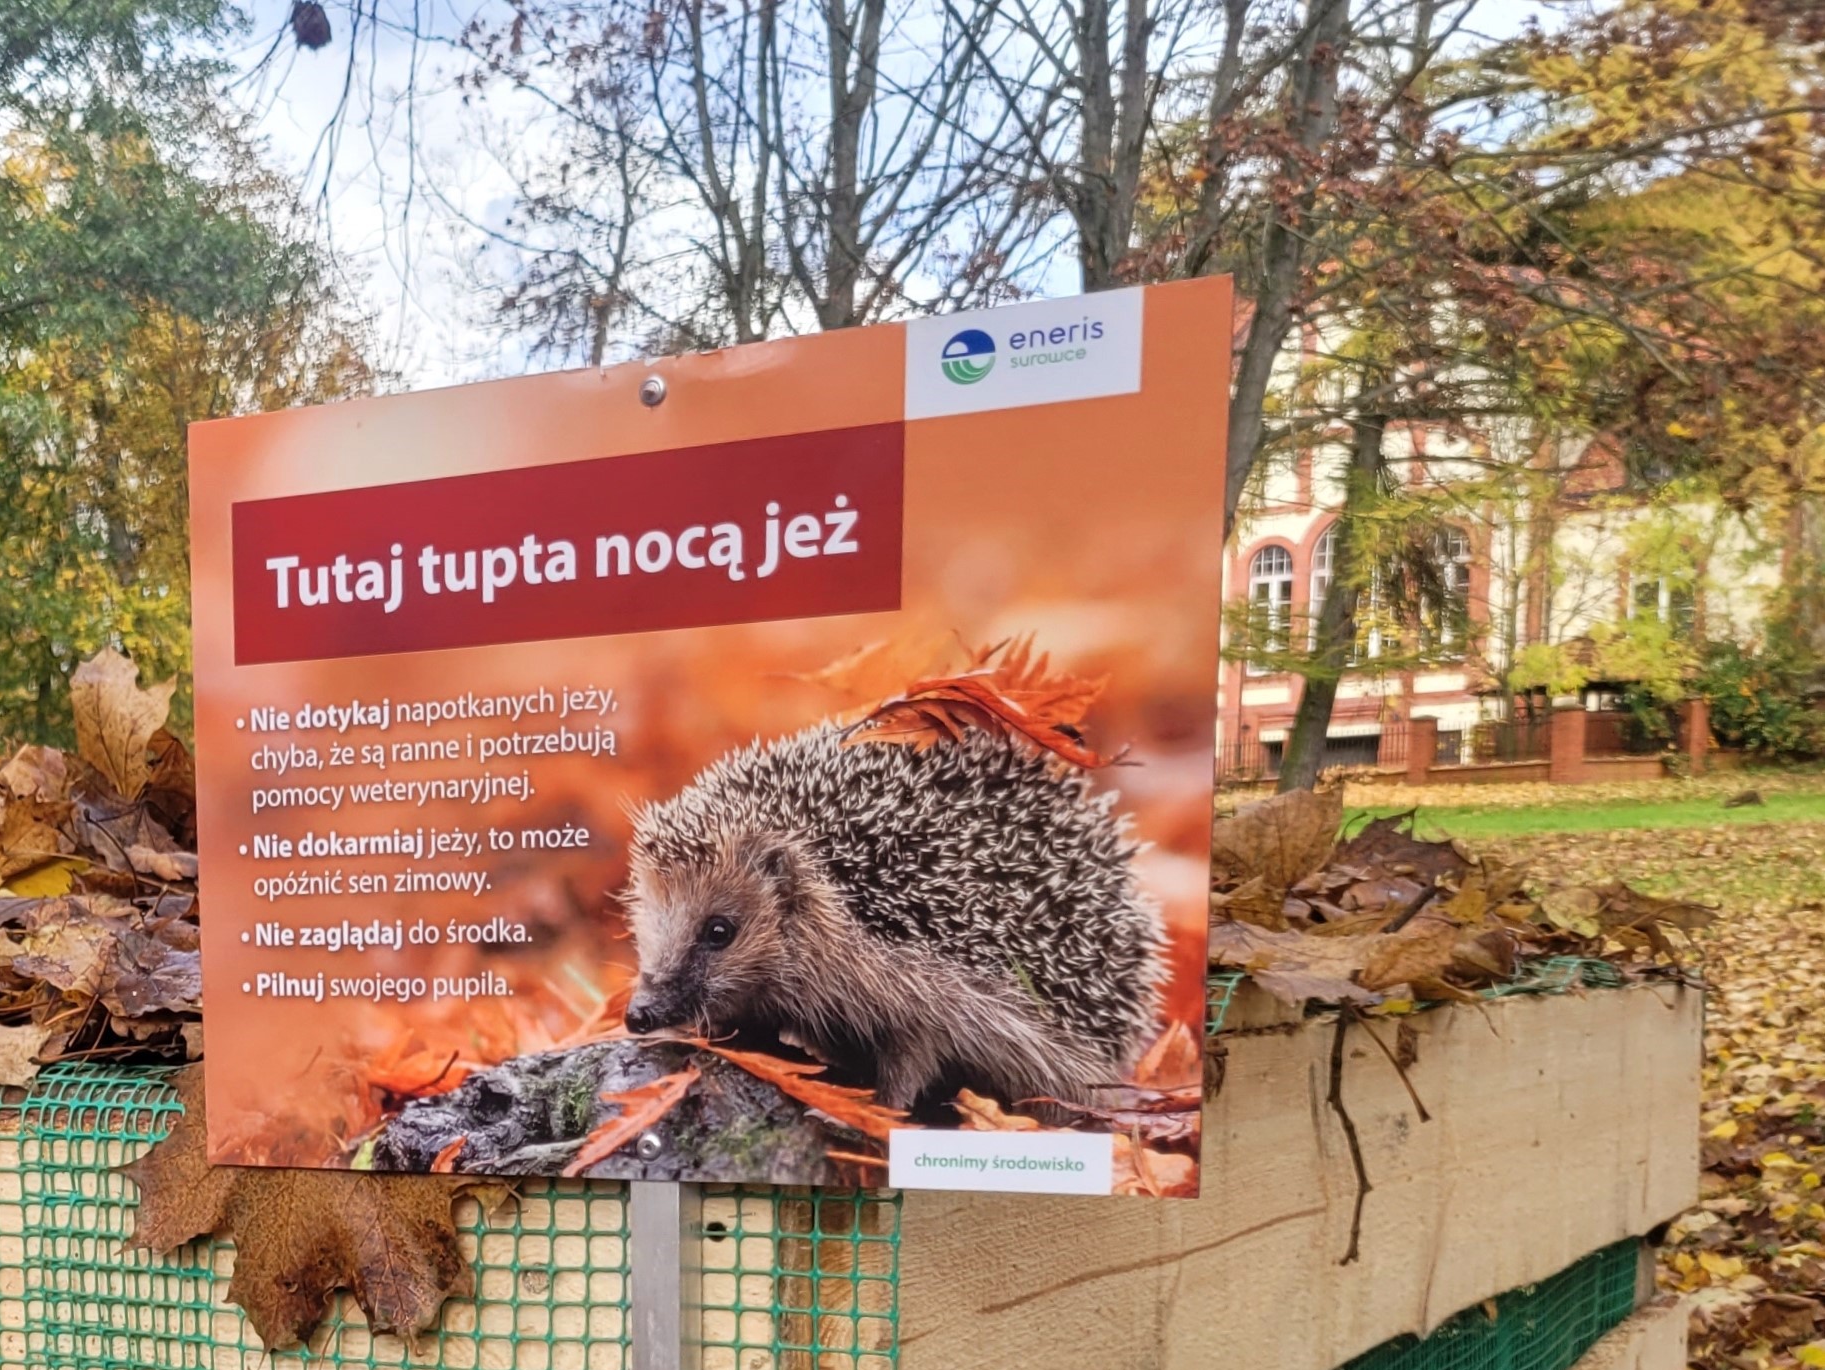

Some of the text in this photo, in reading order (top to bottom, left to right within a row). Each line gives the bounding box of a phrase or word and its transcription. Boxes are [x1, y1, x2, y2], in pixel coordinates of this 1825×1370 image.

[1009, 317, 1104, 350] eneris
[1010, 348, 1086, 368] surowce
[266, 494, 859, 613] Tutaj tupta nocą jeż
[250, 685, 618, 733] Nie dotykaj napotkanych jeży,
[251, 725, 616, 775] chyba, że są ranne i potrzebują
[253, 770, 535, 813] pomocy weterynaryjnej.
[253, 823, 589, 859] Nie dokarmiaj jeży, to może
[254, 868, 491, 901] opóźnić sen zimowy.
[255, 917, 533, 951] Nie zaglądaj do środka.
[257, 970, 514, 1002] Pilnuj swojego pupila.
[915, 1153, 1084, 1171] chronimy środowisko
